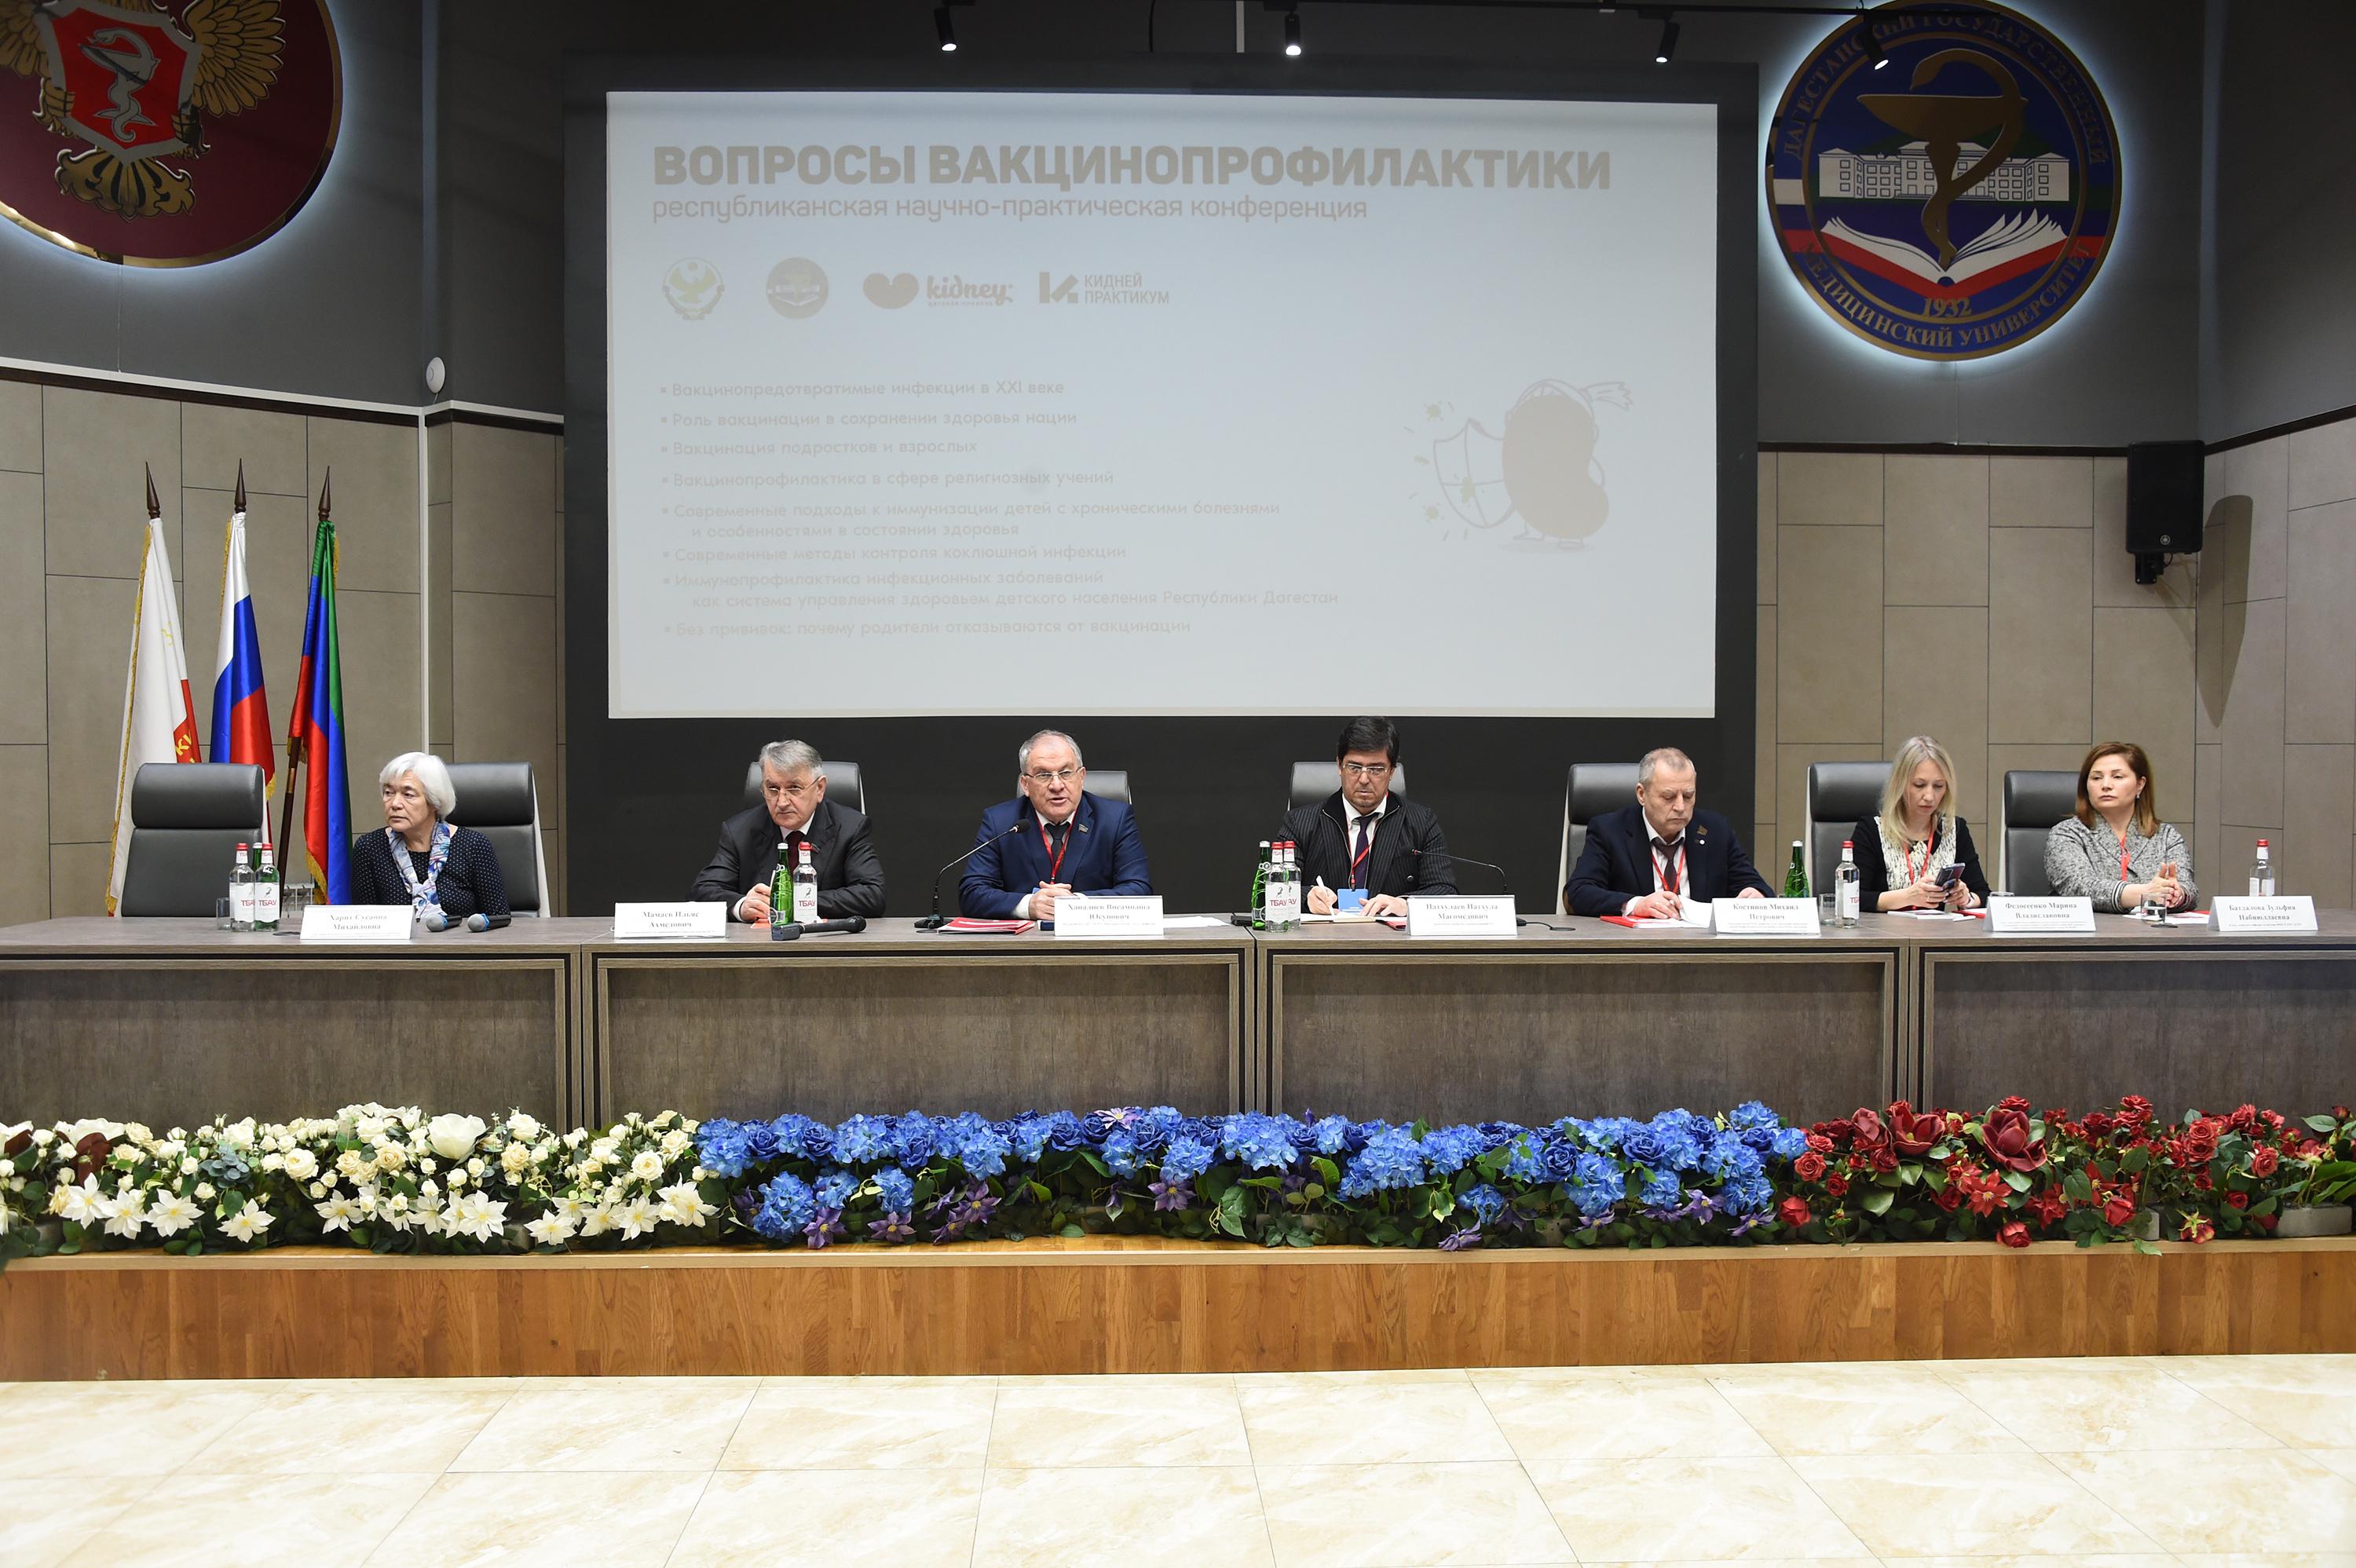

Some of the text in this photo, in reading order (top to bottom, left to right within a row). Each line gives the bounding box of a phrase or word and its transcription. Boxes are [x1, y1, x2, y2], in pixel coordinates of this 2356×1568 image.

[653, 144, 1612, 192] ВОПРОСЫ ВАКЦИНОПРОФИЛАКТИКИ
[653, 195, 1367, 223] республиканская научно-практическая конференция
[1085, 272, 1143, 288] КИДНЕЙ
[926, 274, 1013, 307] kidney
[1085, 290, 1169, 305] ПРАКТИКУМ
[1800, 241, 2090, 347] МЕДИЦИНСКИЙ УНИВЕРСИТЕТ
[1922, 298, 1973, 318] 1932
[672, 383, 885, 399] Вакцинопредотвратимые
[892, 381, 975, 397] инфекции
[981, 383, 990, 393] в
[1028, 383, 1064, 393] веке
[672, 412, 1077, 429] Роль вакцинации в сохранении здоровья нации
[673, 442, 978, 457] Вакцинация подростков и взрослых
[674, 470, 1114, 489] Вакцинопрофилактика в сфере религиозных учений
[674, 502, 1280, 521] Современные подходы к иммунизации детей с хроническими болезнями
[692, 524, 1019, 539] и особенностями в состоянии здоровья
[675, 543, 1126, 565] Современные методы контроля коклюшной инфекции
[675, 569, 1103, 590] Иммунопрофилактика инфекционных заболеваний
[693, 590, 1338, 609] как система управления здоровьем детского населения Республики Дагестан
[676, 620, 1191, 639] Без прививок: почему родители отказываются от вакцинации
